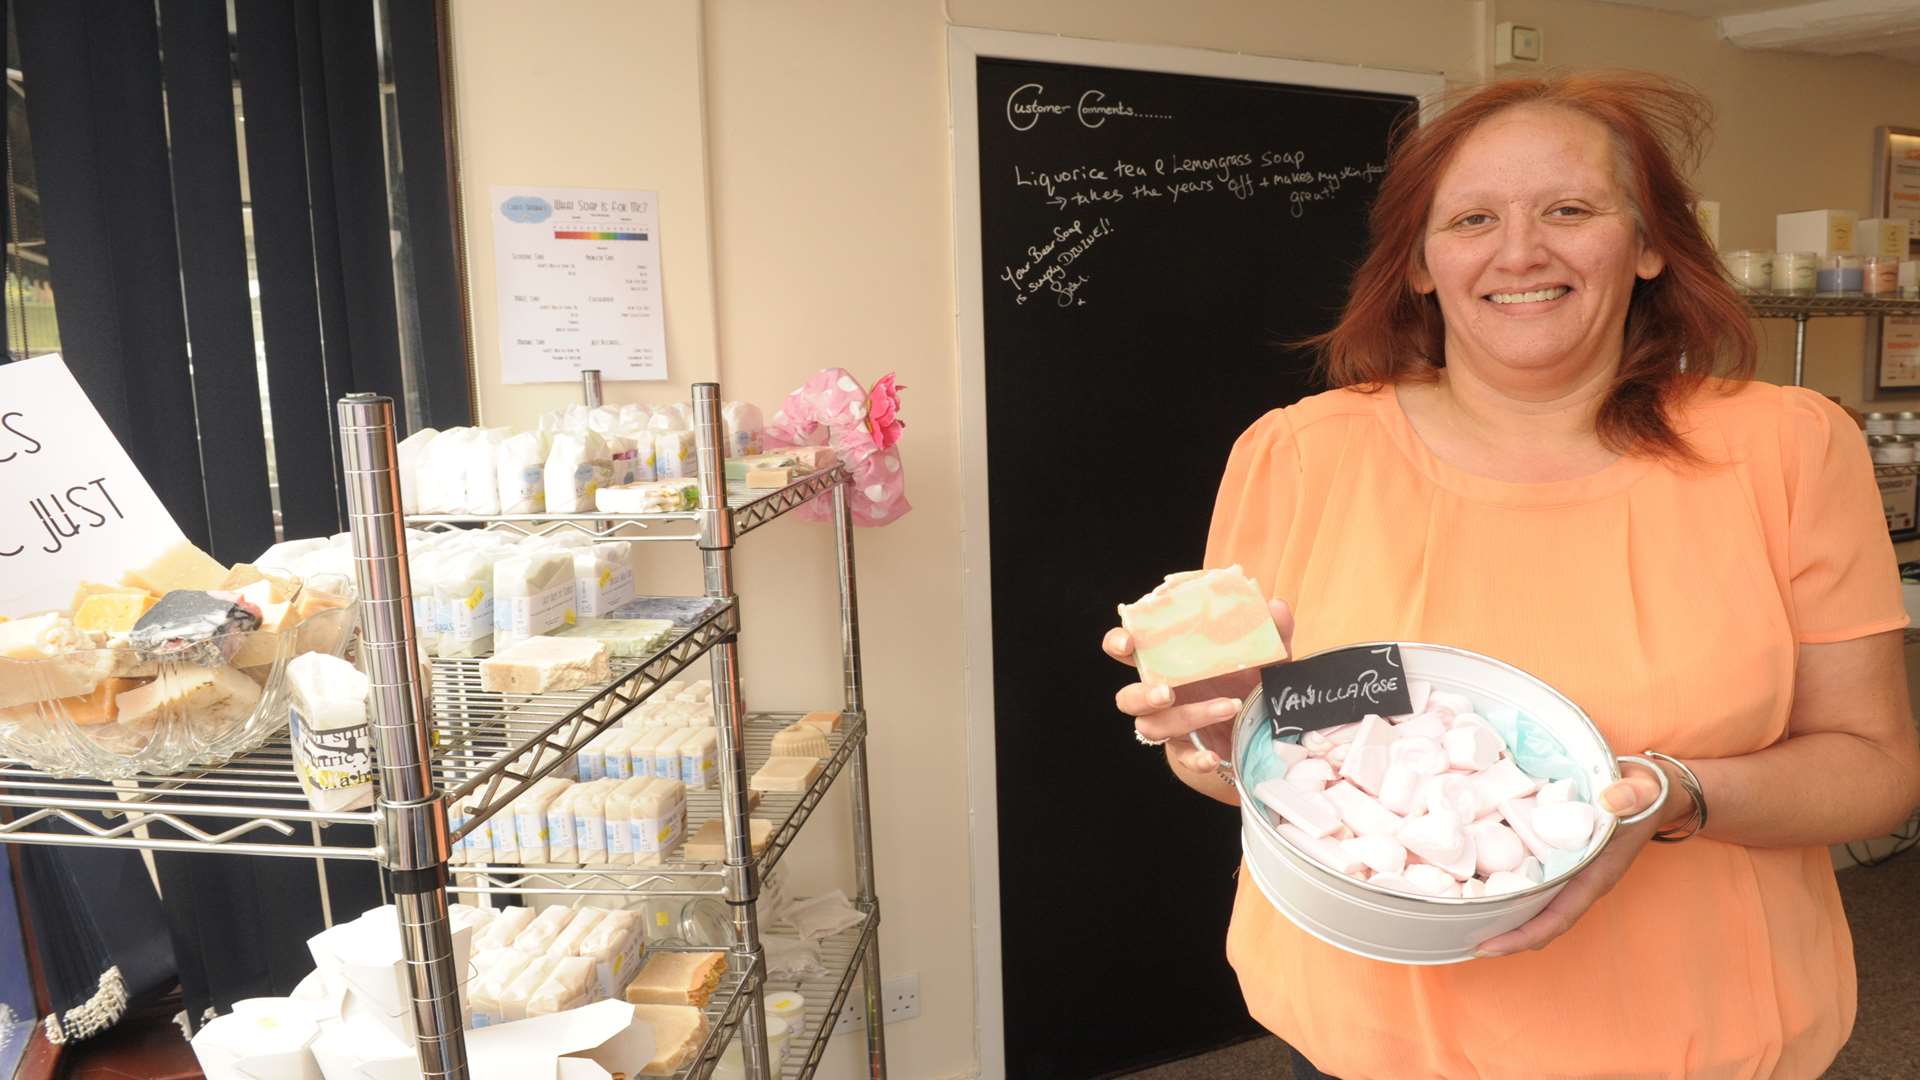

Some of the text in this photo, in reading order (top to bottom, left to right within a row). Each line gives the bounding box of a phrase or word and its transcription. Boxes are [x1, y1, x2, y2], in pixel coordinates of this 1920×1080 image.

[1007, 84, 1072, 131] Customer
[1015, 165, 1109, 197] Liquorice
[1114, 160, 1147, 177] tea
[1173, 153, 1252, 183] Lemongrass
[1071, 188, 1124, 206] takes
[1133, 184, 1163, 199] the
[1167, 179, 1214, 203] years
[1340, 165, 1362, 180] skin
[1000, 219, 1083, 291] Your Beer Soap
[1028, 264, 1067, 293] simply
[29, 477, 124, 553] JUST
[1271, 682, 1359, 716] VANILLA
